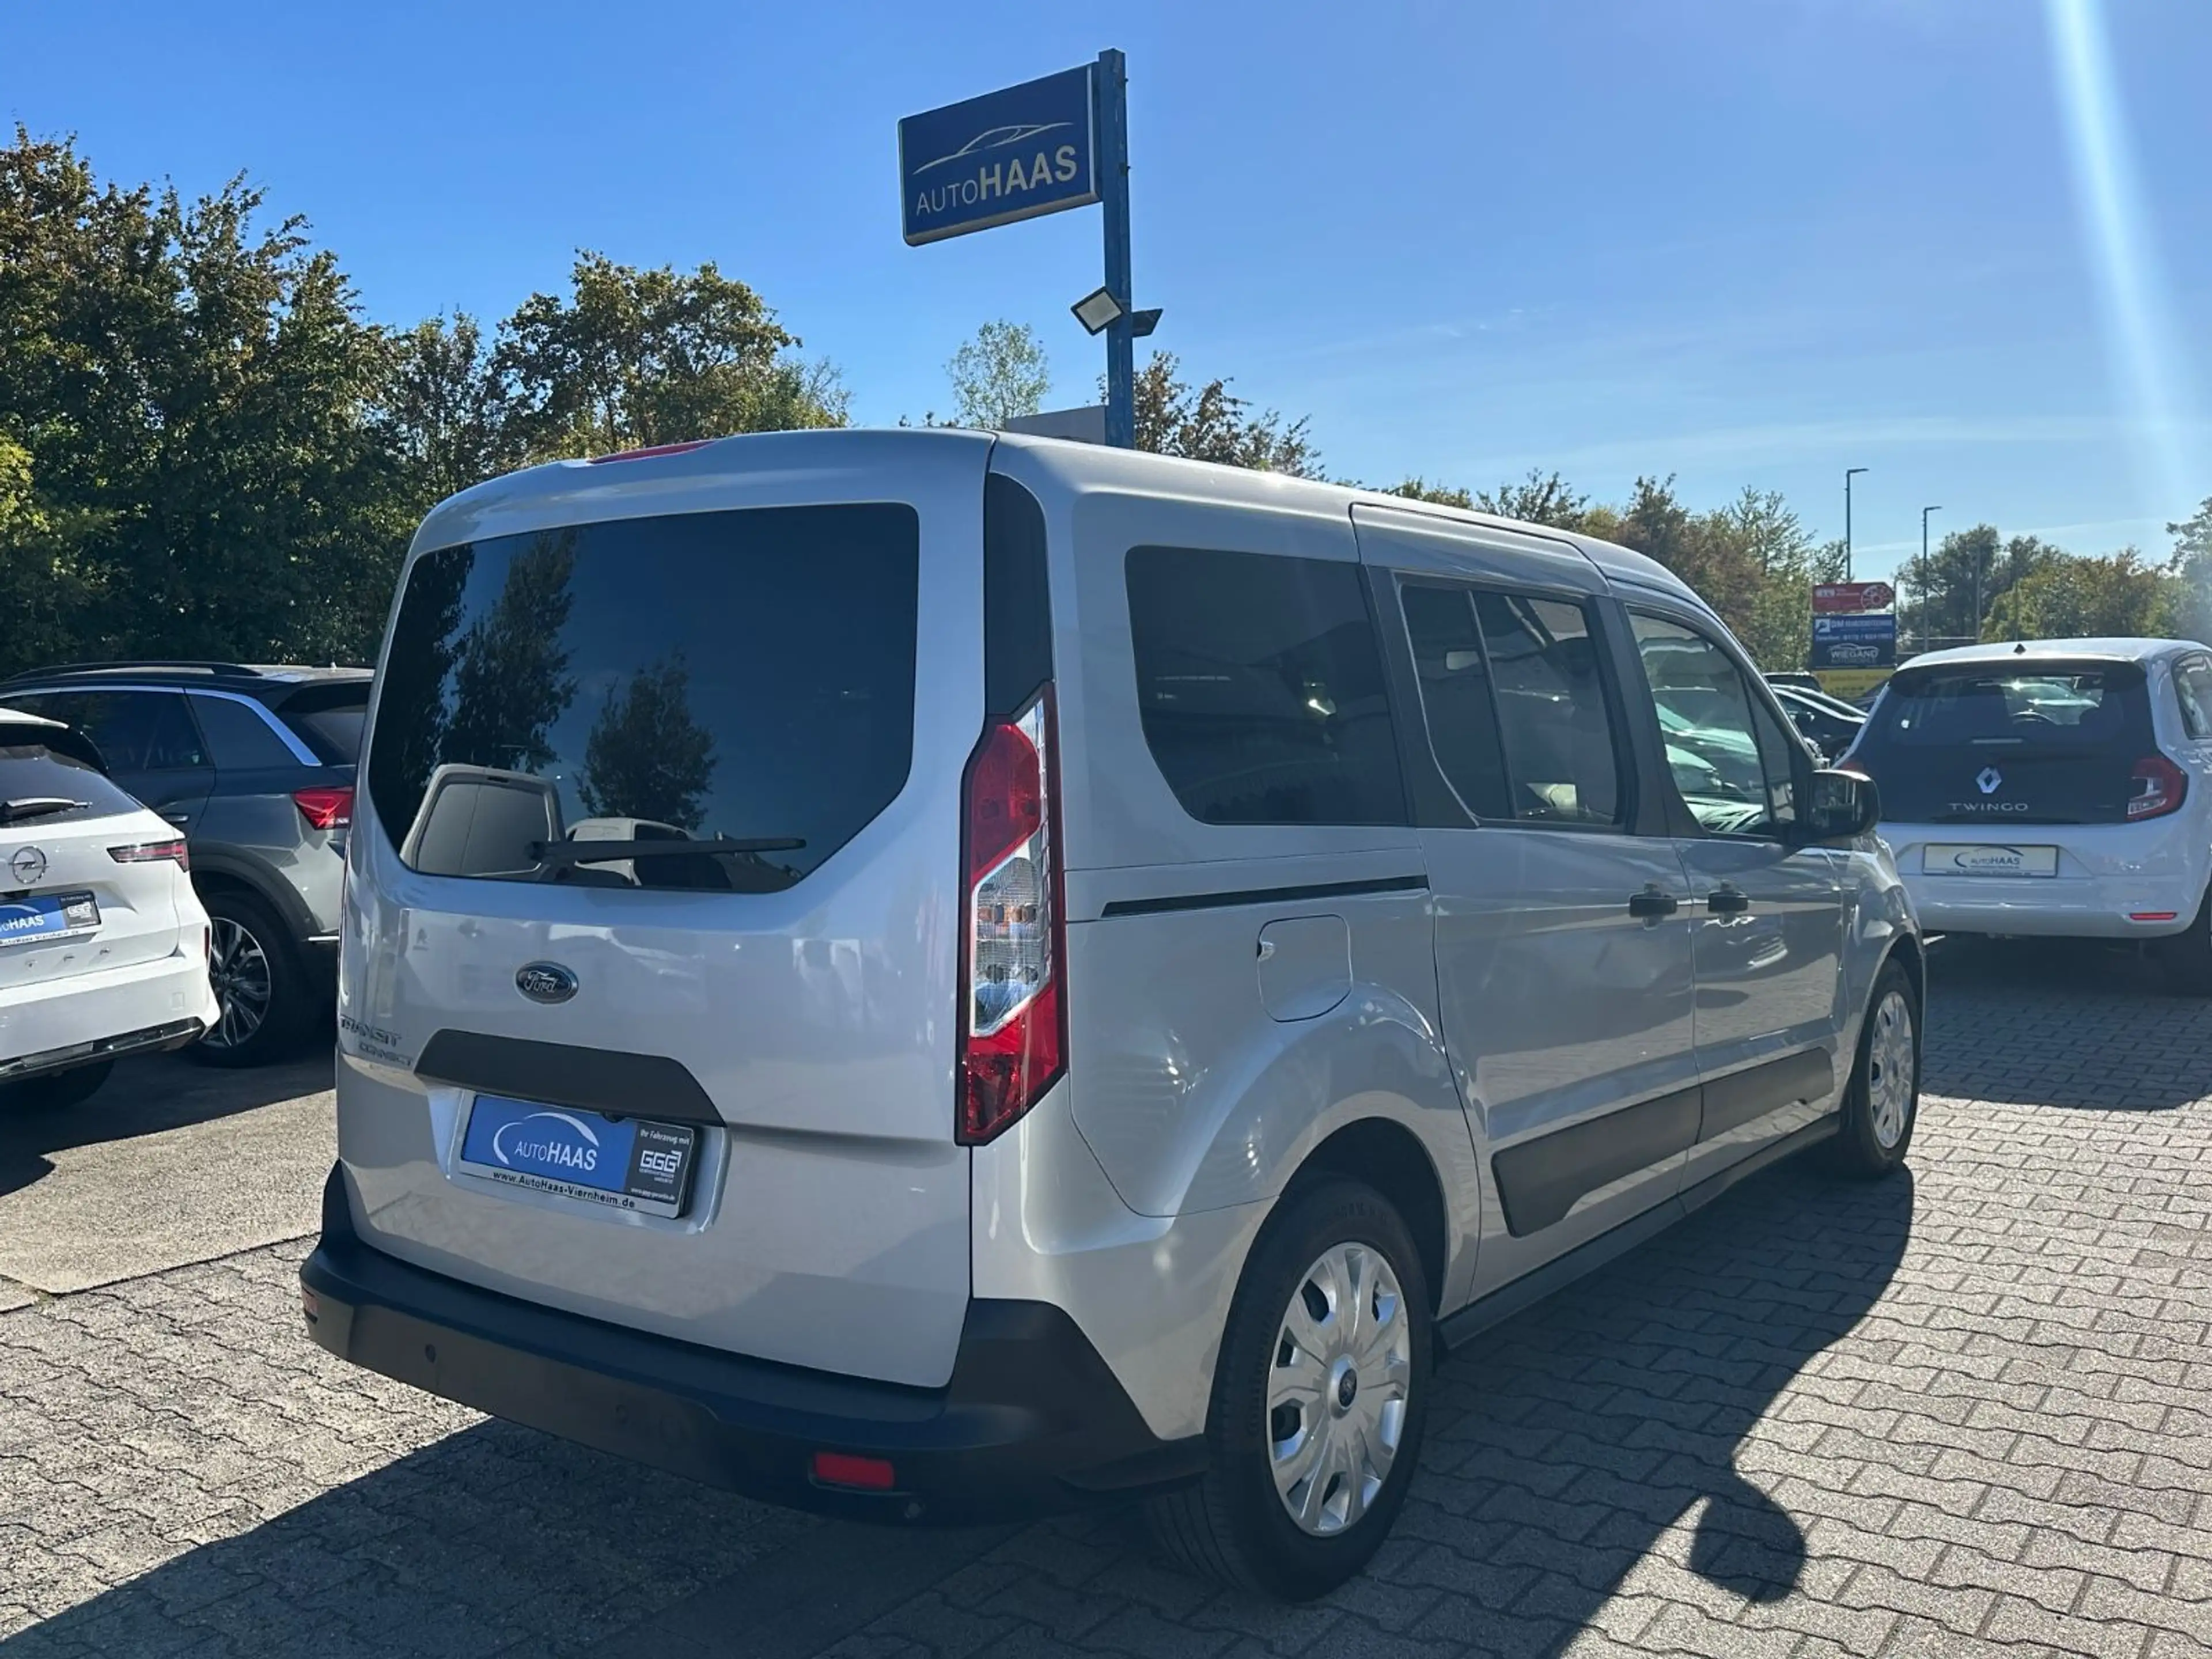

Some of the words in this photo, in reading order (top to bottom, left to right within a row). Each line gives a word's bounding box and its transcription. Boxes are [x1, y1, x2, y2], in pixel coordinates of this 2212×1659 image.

[915, 145, 1078, 217] AUTOHAAS
[1831, 649, 1878, 658] WIEGAND
[1948, 802, 2029, 811] TWINGO
[524, 970, 559, 994] Ford
[339, 1013, 402, 1047] TRANSIT
[514, 1140, 598, 1171] AUTOHAAS
[640, 1150, 678, 1173] GGG
[493, 1171, 636, 1208] www.AutoHaas-Viernheim.de
